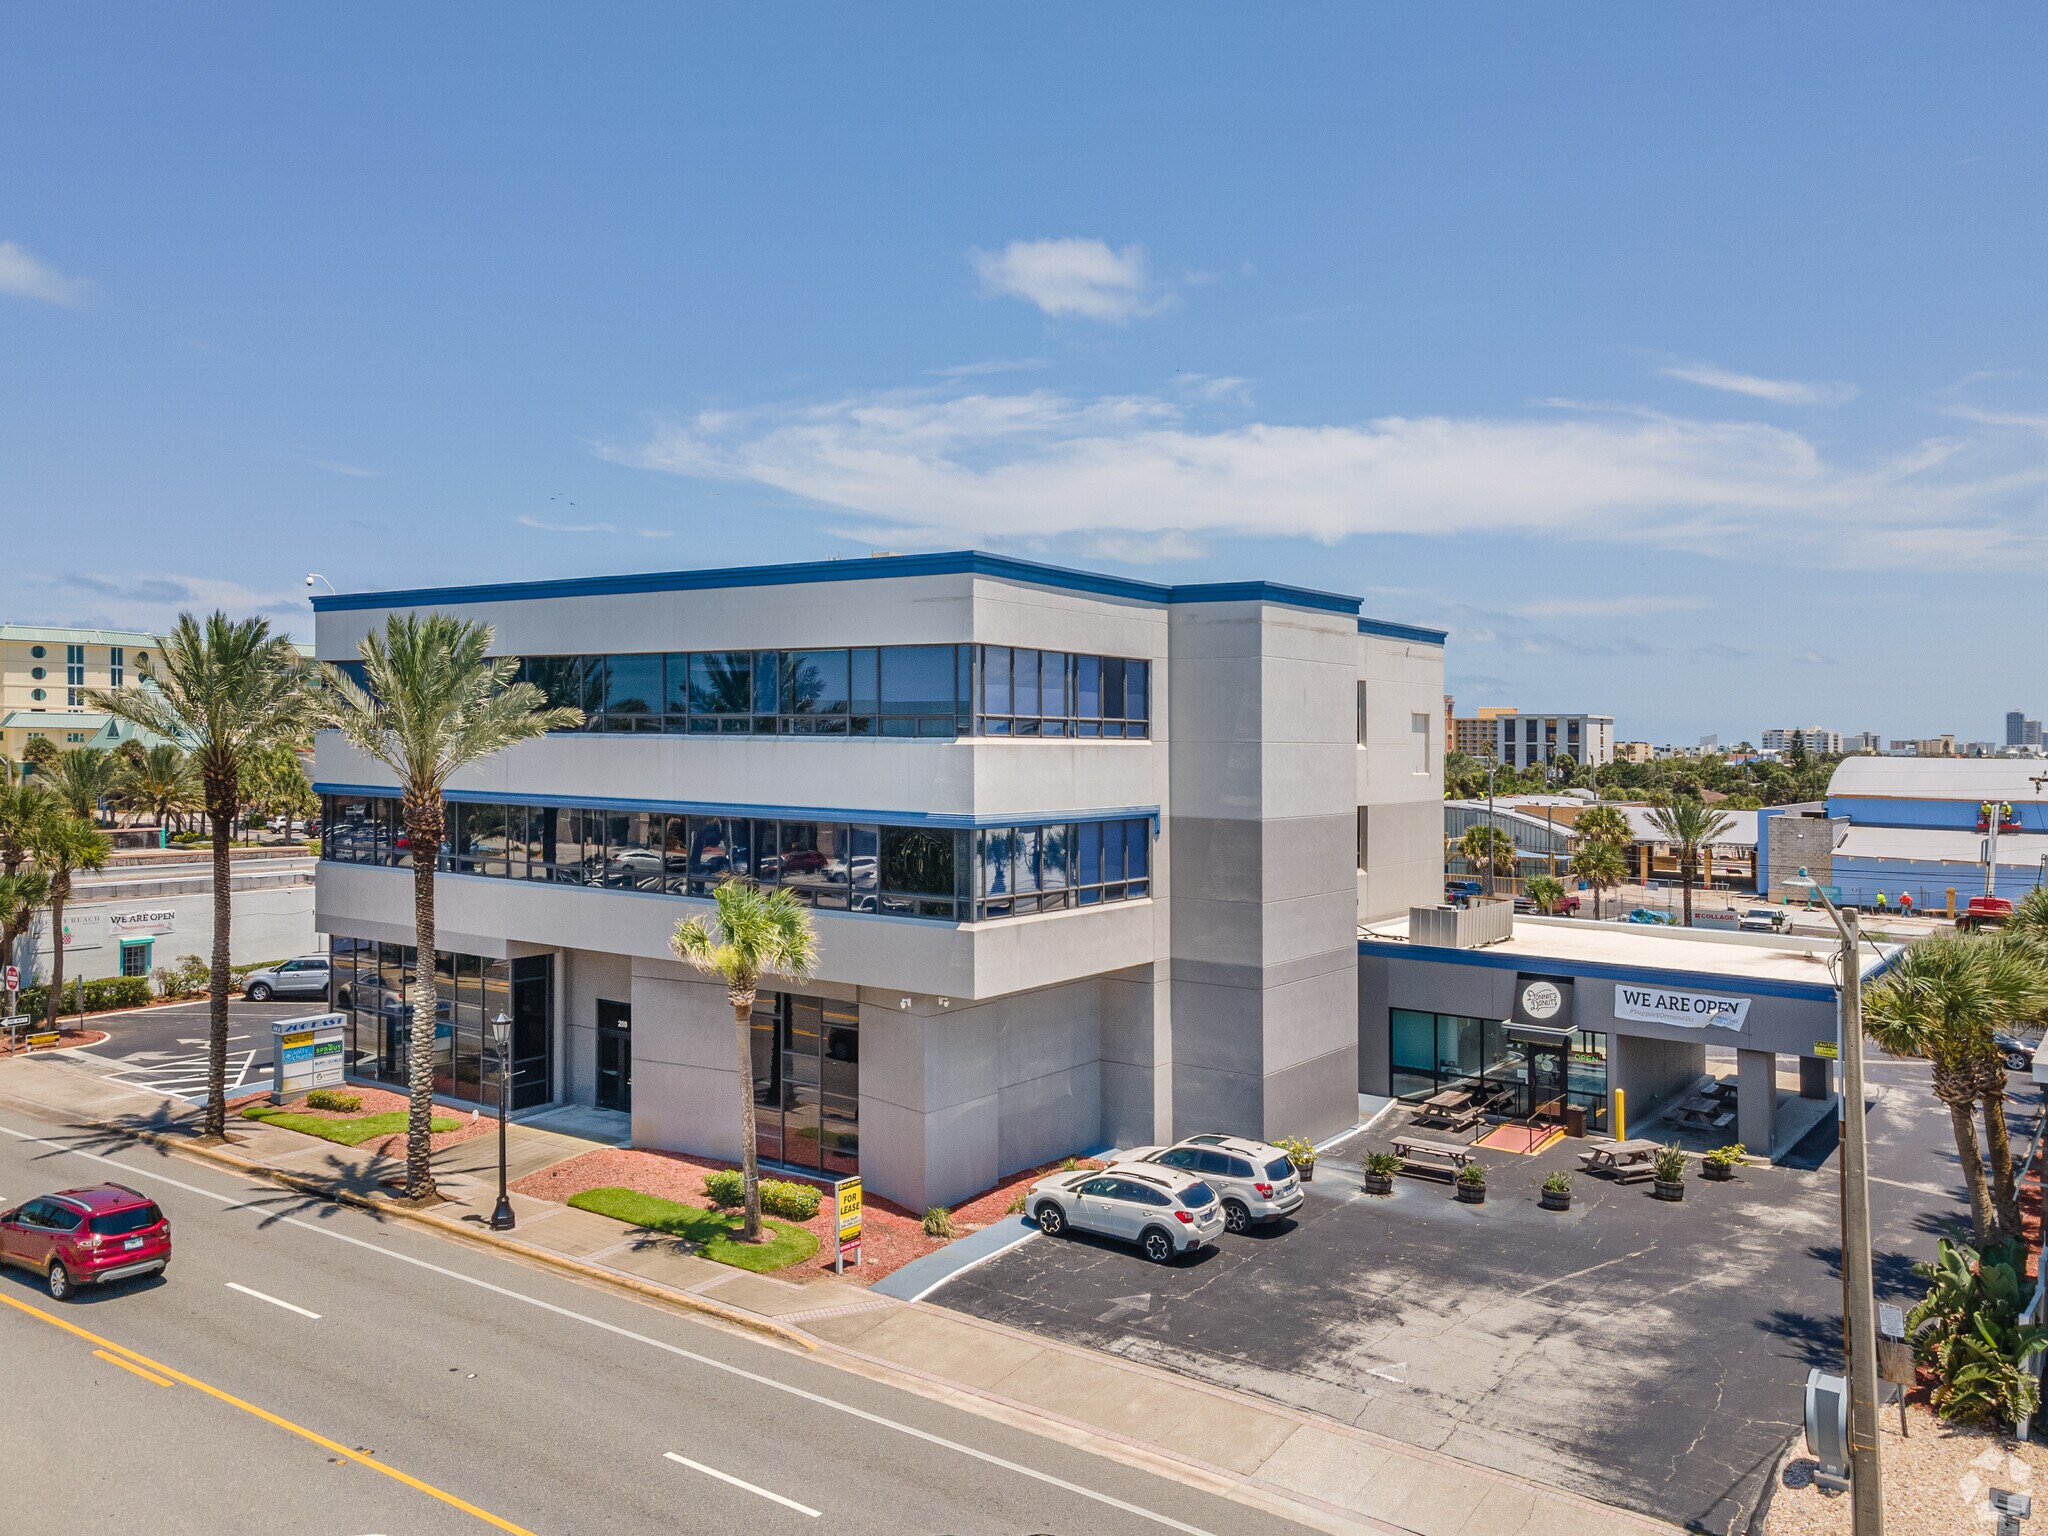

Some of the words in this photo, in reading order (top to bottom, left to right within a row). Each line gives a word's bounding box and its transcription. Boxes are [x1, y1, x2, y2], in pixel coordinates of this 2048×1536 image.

[110, 915, 127, 924] WE
[129, 913, 149, 923] ARE
[150, 912, 175, 921] OPEN
[1700, 913, 1735, 921] COLLAGE
[1527, 988, 1557, 1001] DONNIE'S
[1530, 1000, 1557, 1011] DONUTS
[1623, 990, 1651, 1007] WE
[1655, 995, 1690, 1012] ARE
[1694, 999, 1739, 1015] OPEN
[1574, 1054, 1599, 1063] OPEN
[843, 1193, 857, 1205] FOR
[840, 1202, 860, 1215] LEASE
